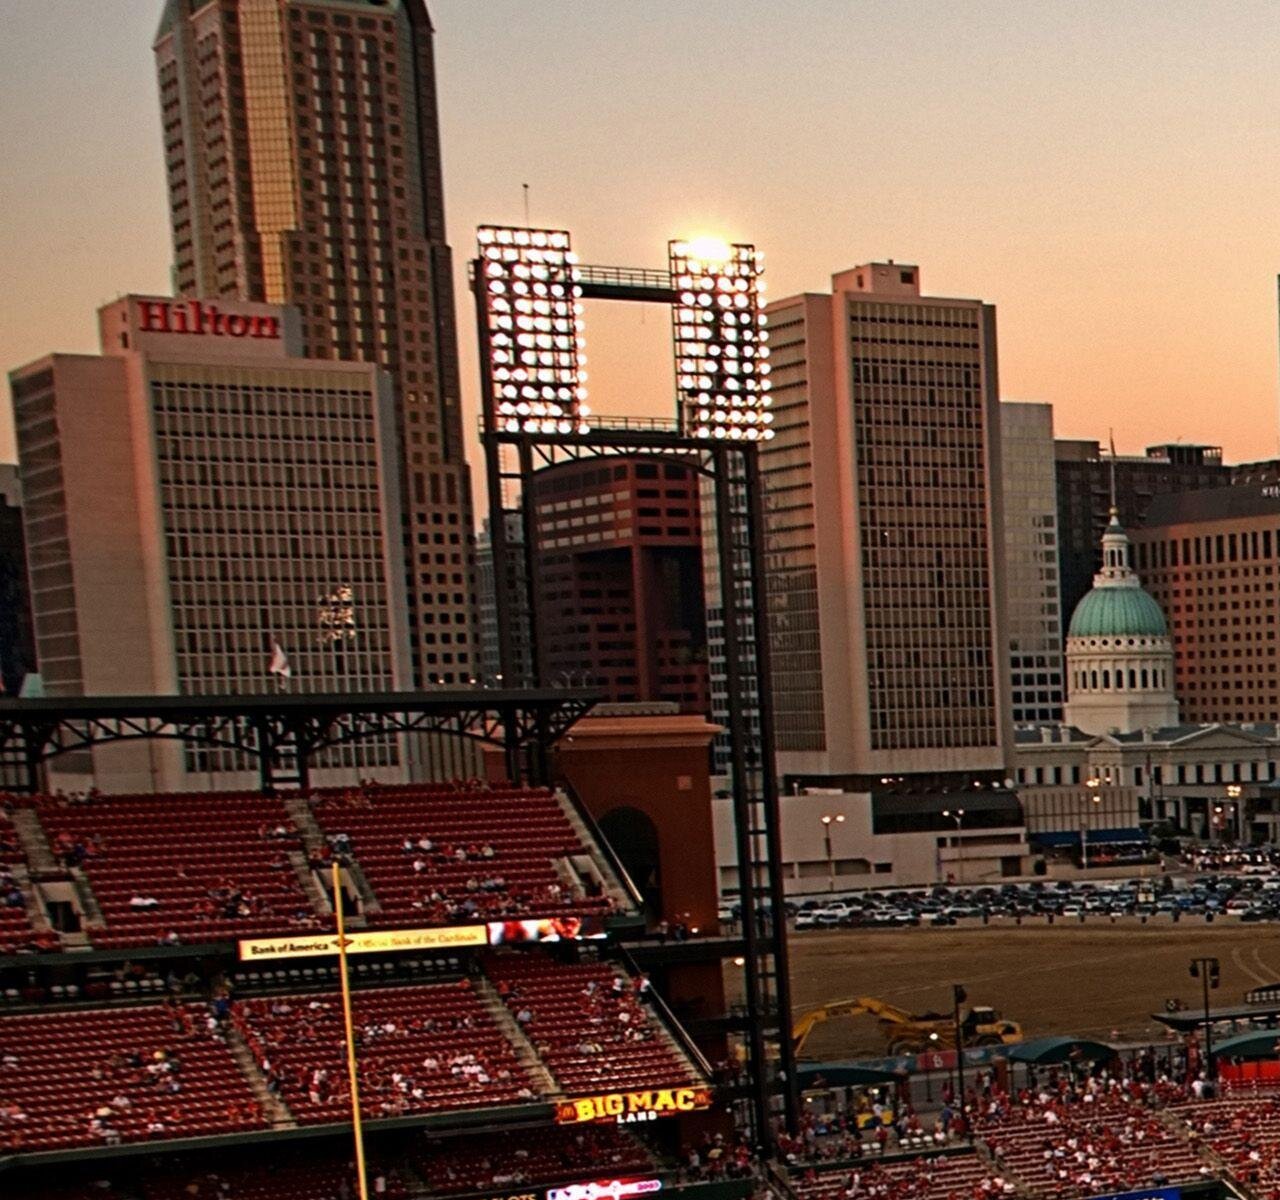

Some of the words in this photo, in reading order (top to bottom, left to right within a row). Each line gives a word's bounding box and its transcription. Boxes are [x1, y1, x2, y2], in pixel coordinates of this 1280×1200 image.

[138, 300, 281, 339] Hilton
[289, 942, 329, 952] America
[574, 1094, 624, 1121] BIG
[628, 1089, 695, 1112] MAC
[617, 1111, 658, 1123] LAND
